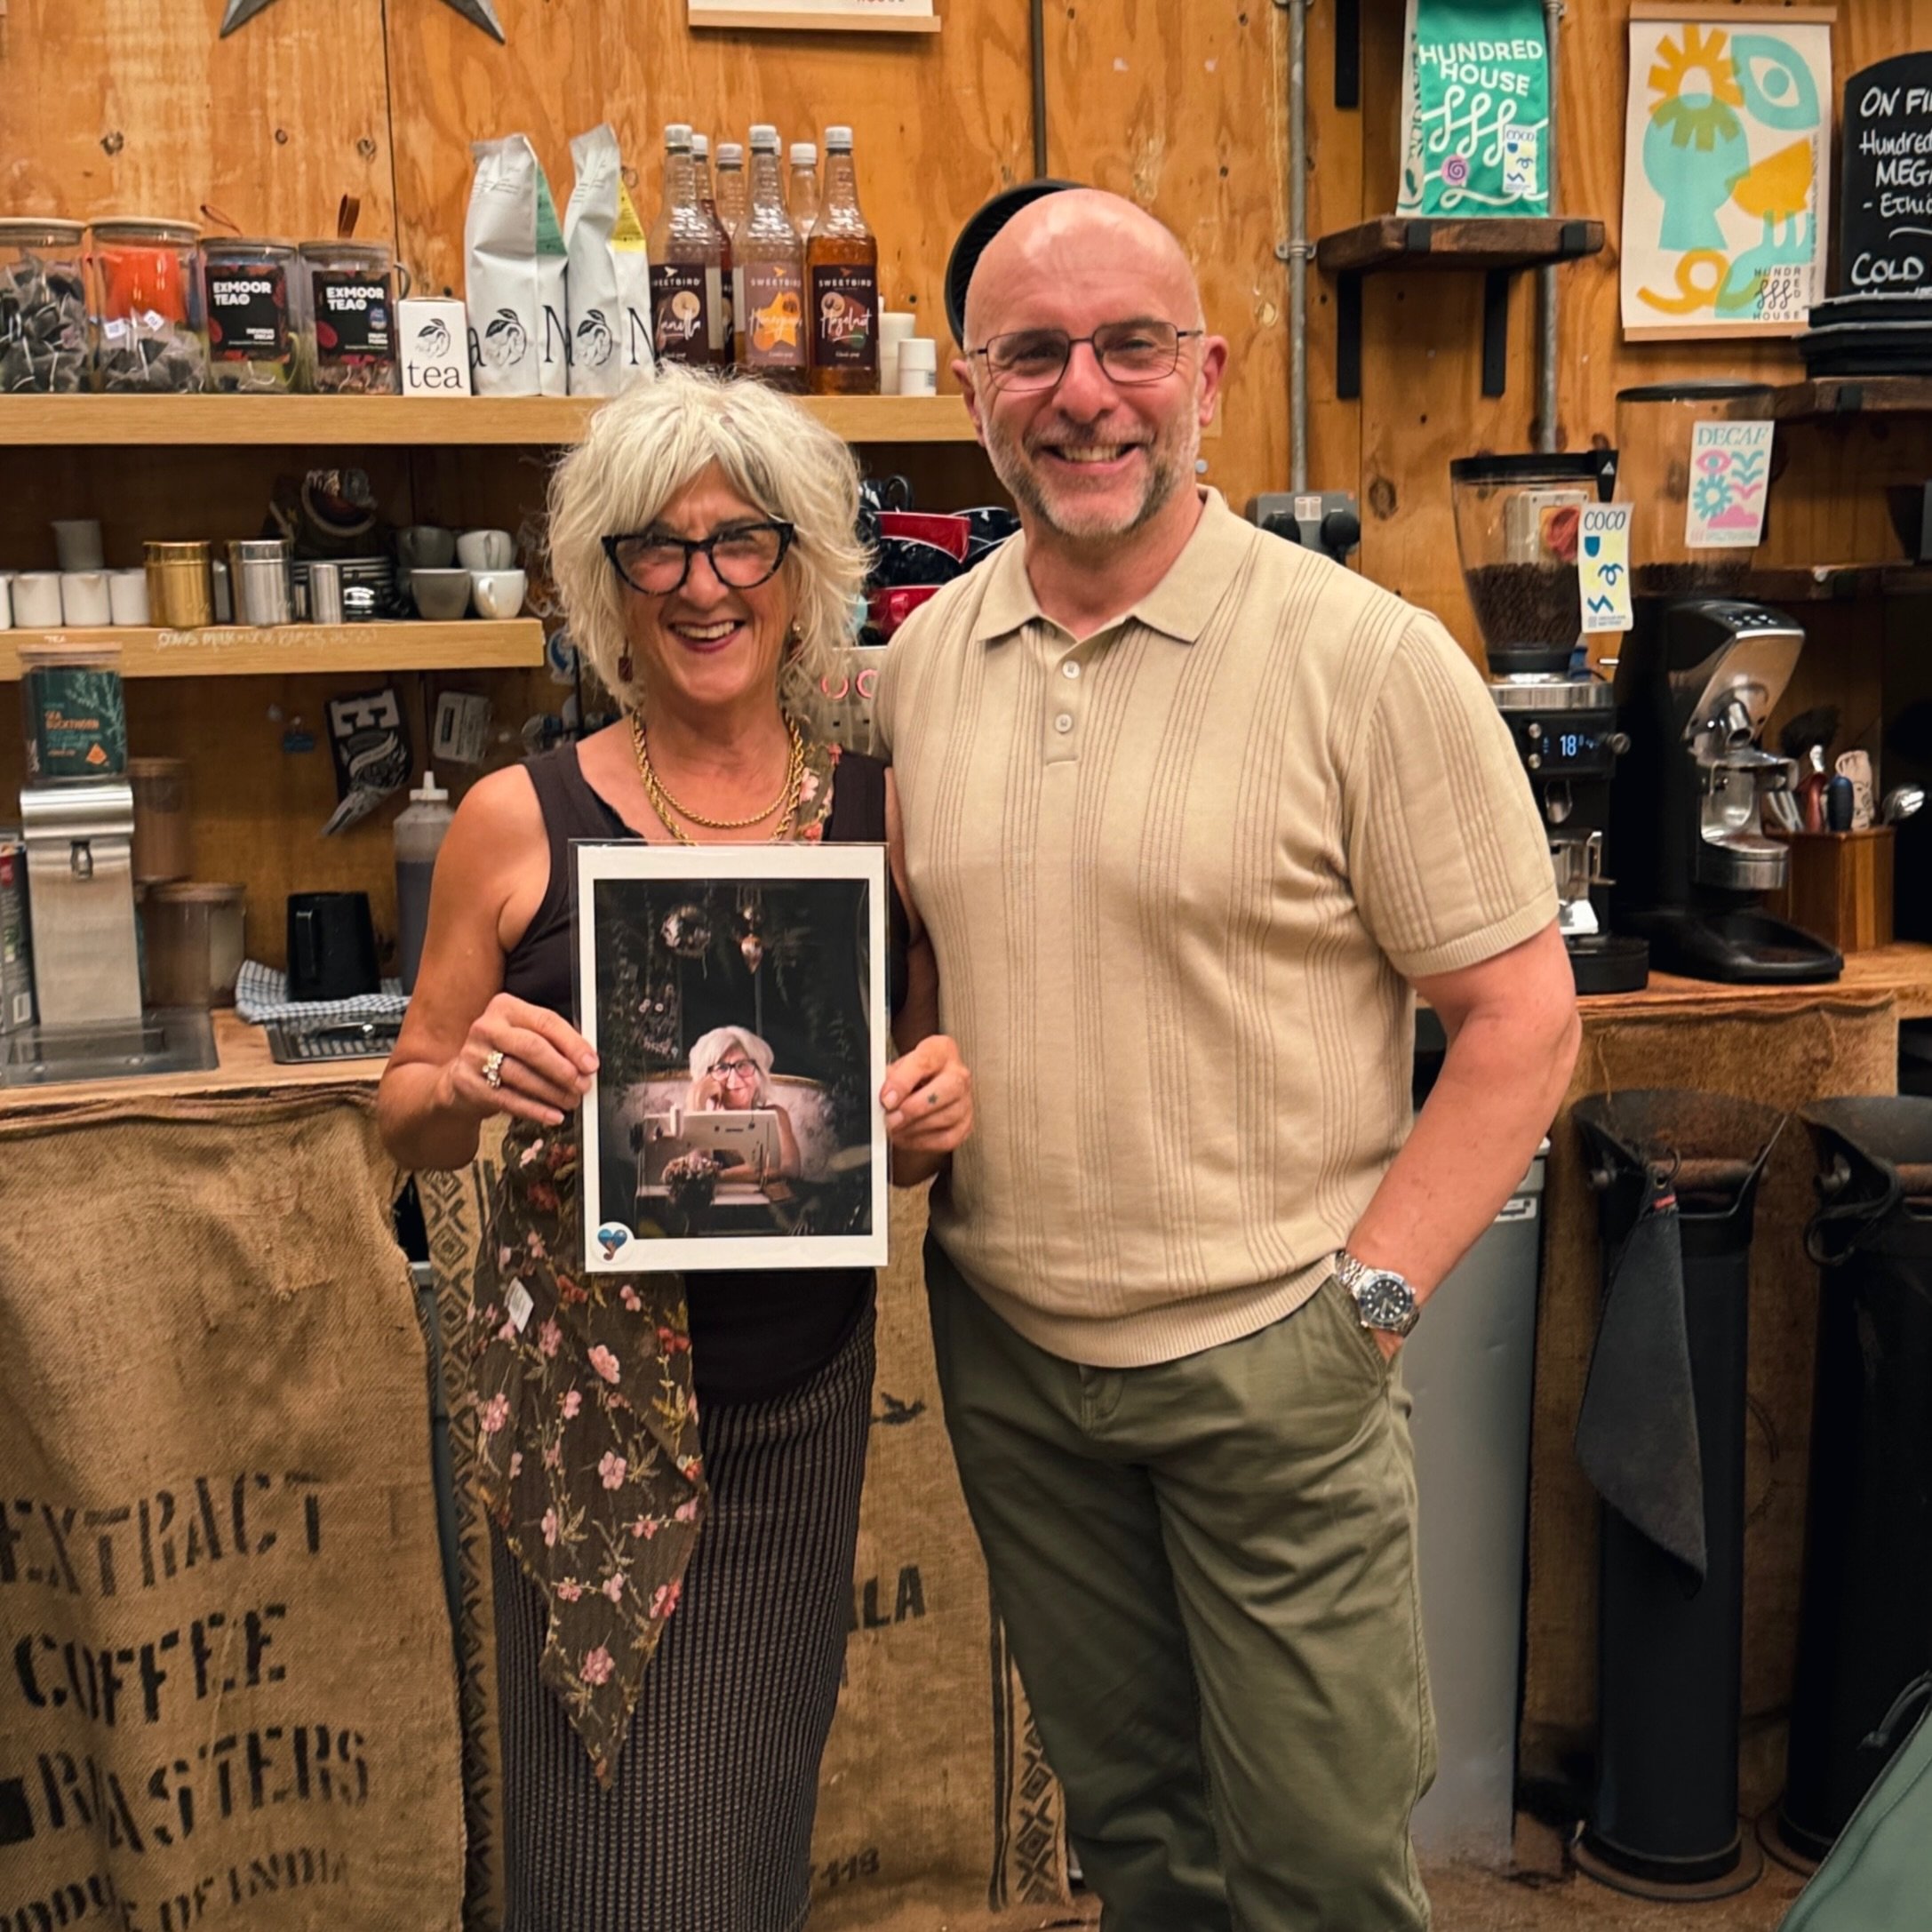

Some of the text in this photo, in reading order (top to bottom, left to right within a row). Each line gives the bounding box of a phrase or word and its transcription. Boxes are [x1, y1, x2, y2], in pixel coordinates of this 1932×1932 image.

[1419, 40, 1543, 65] HUNDRED
[1441, 60, 1530, 97] HOUSE
[1860, 87, 1901, 117] ON
[1851, 252, 1924, 286] COLD
[212, 281, 271, 294] EXMOOR
[326, 287, 384, 299] EXMOOR
[818, 278, 872, 288] SWEETBIRD
[1752, 311, 1800, 321] HOUSE
[407, 360, 463, 388] tea
[1697, 427, 1768, 446] DECAF
[1584, 511, 1626, 531] COCO
[0, 1472, 323, 1598] EXTRACT
[847, 1565, 927, 1633] LA
[14, 1603, 287, 1727] COFFEE
